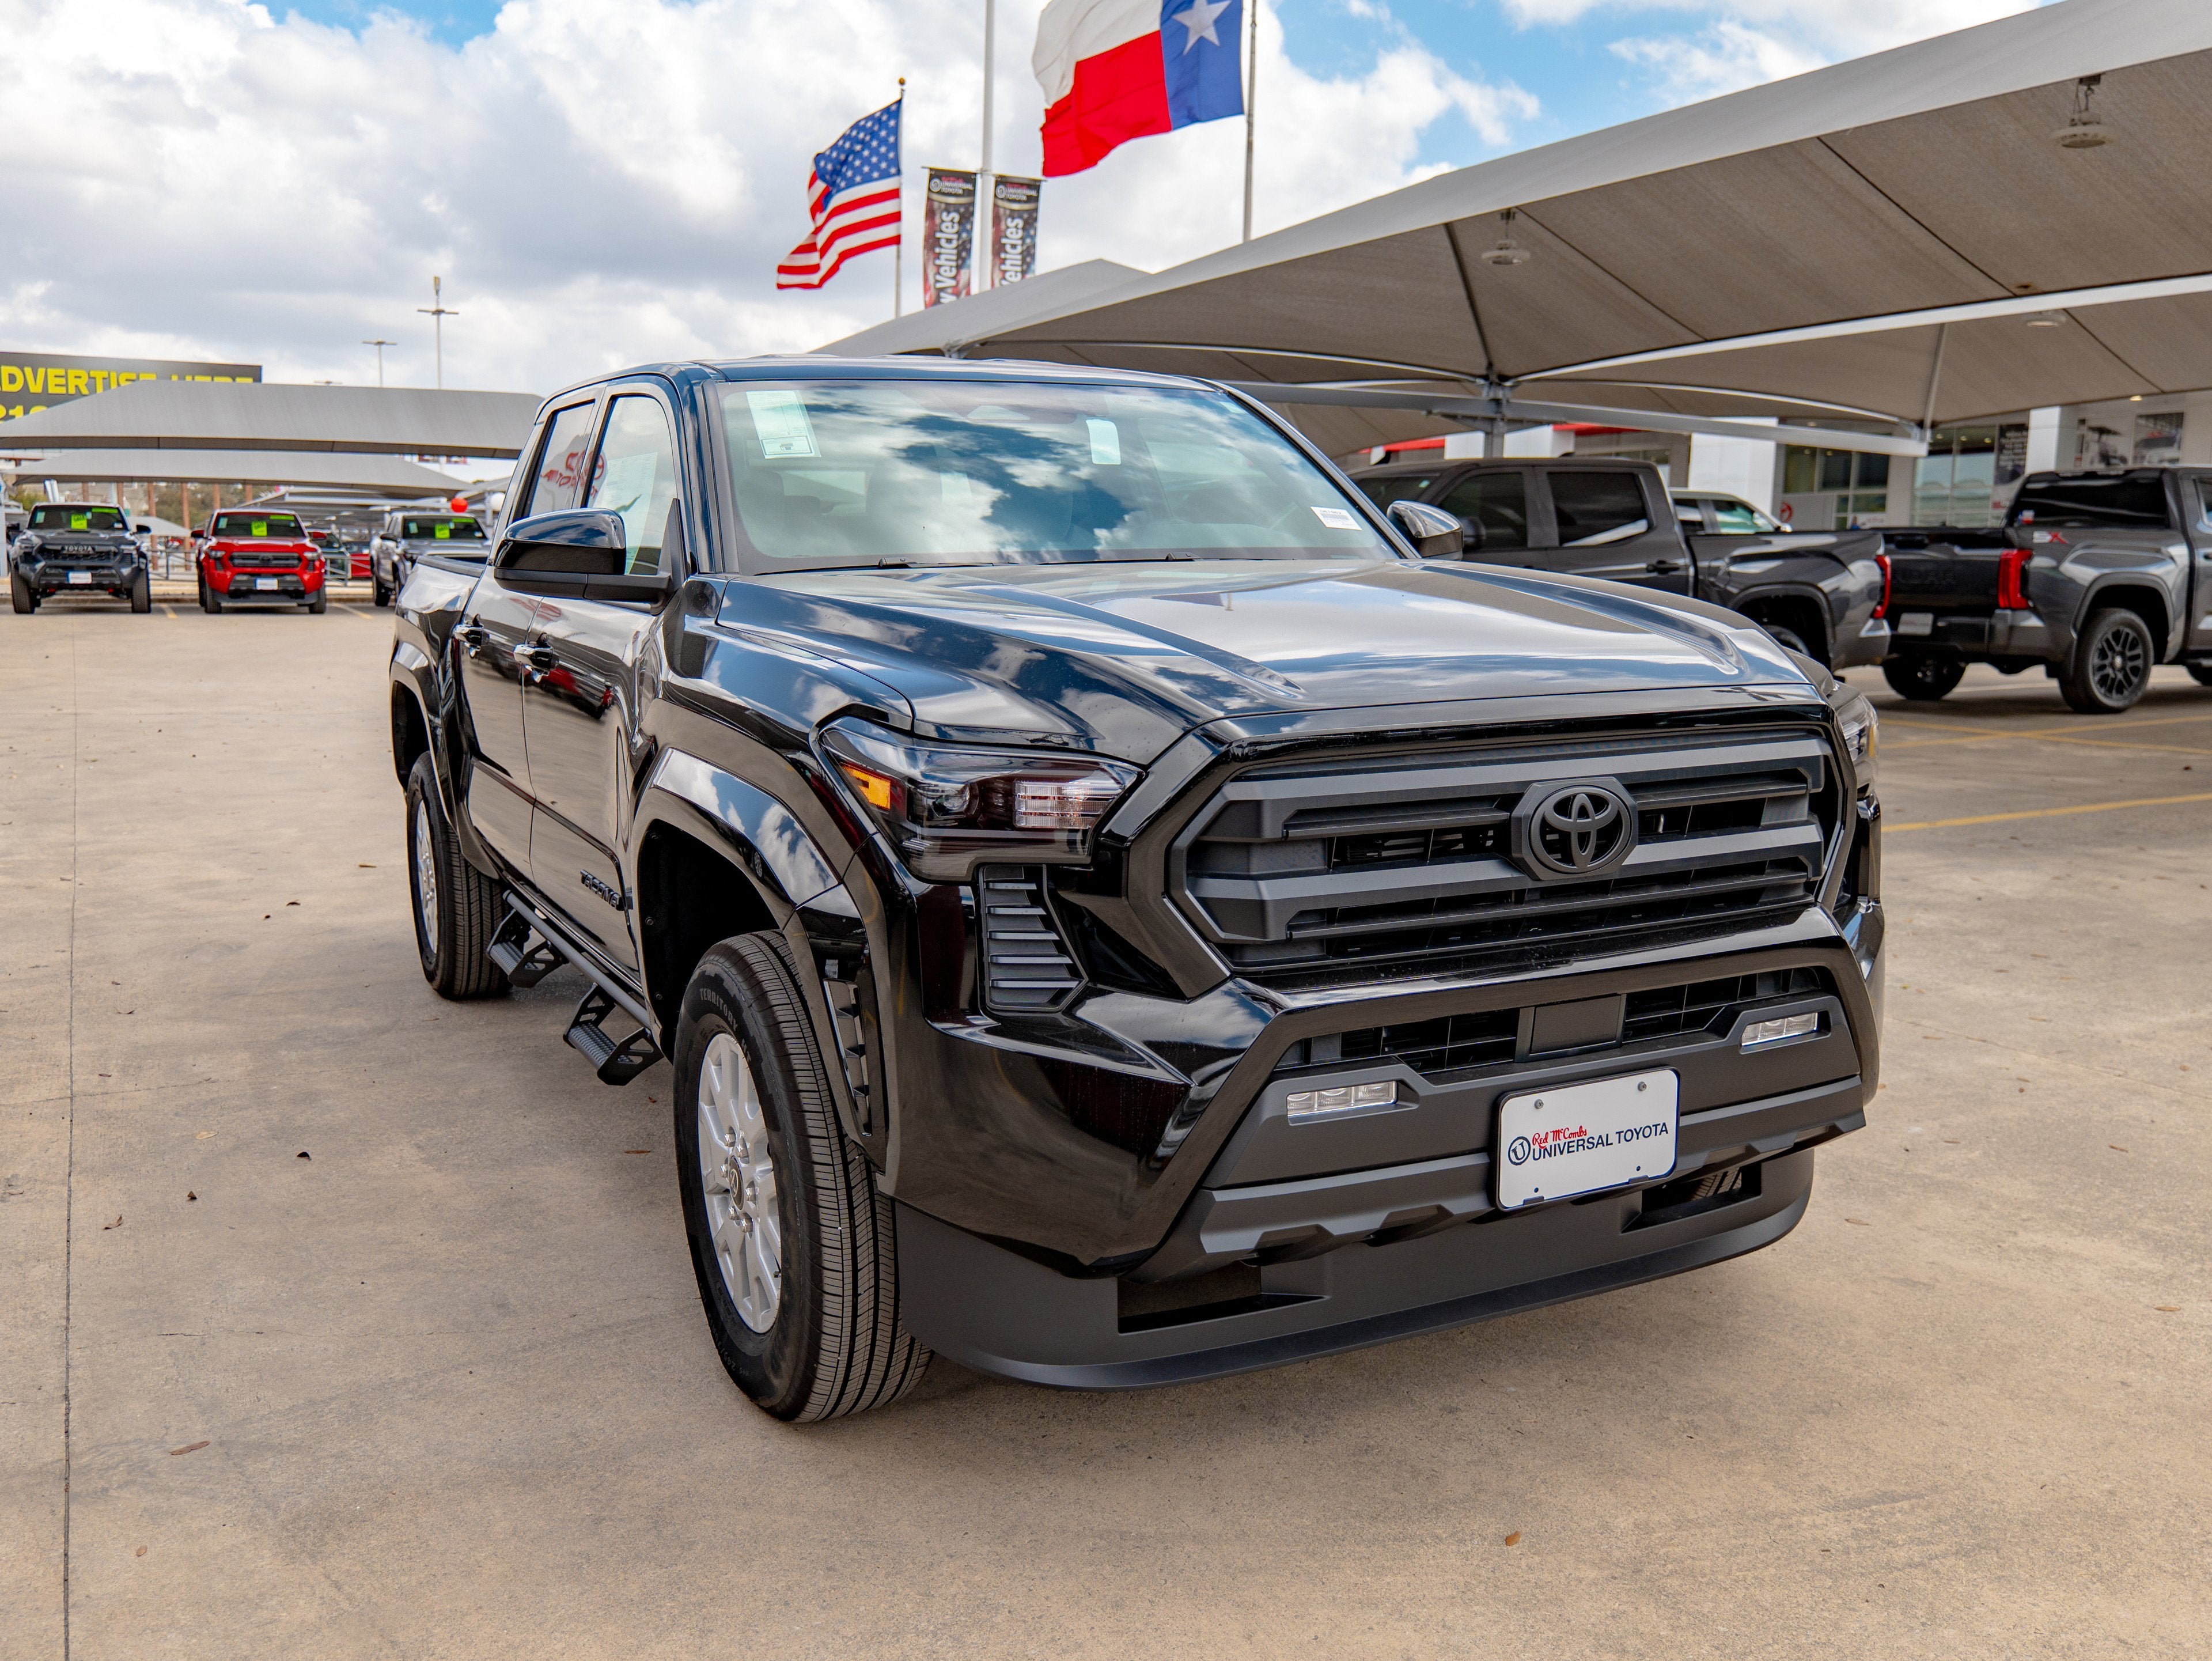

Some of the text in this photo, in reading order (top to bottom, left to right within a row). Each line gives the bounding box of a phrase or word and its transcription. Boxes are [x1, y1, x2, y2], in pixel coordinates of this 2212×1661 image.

[934, 211, 961, 289] Vehicles
[0, 365, 157, 395] DVERTI
[580, 869, 621, 910] TACOMA
[699, 987, 738, 1032] TERRITORY
[1532, 1125, 1587, 1149] Red McCombs
[1532, 1122, 1669, 1161] UNIVERSAL TOYOTA
